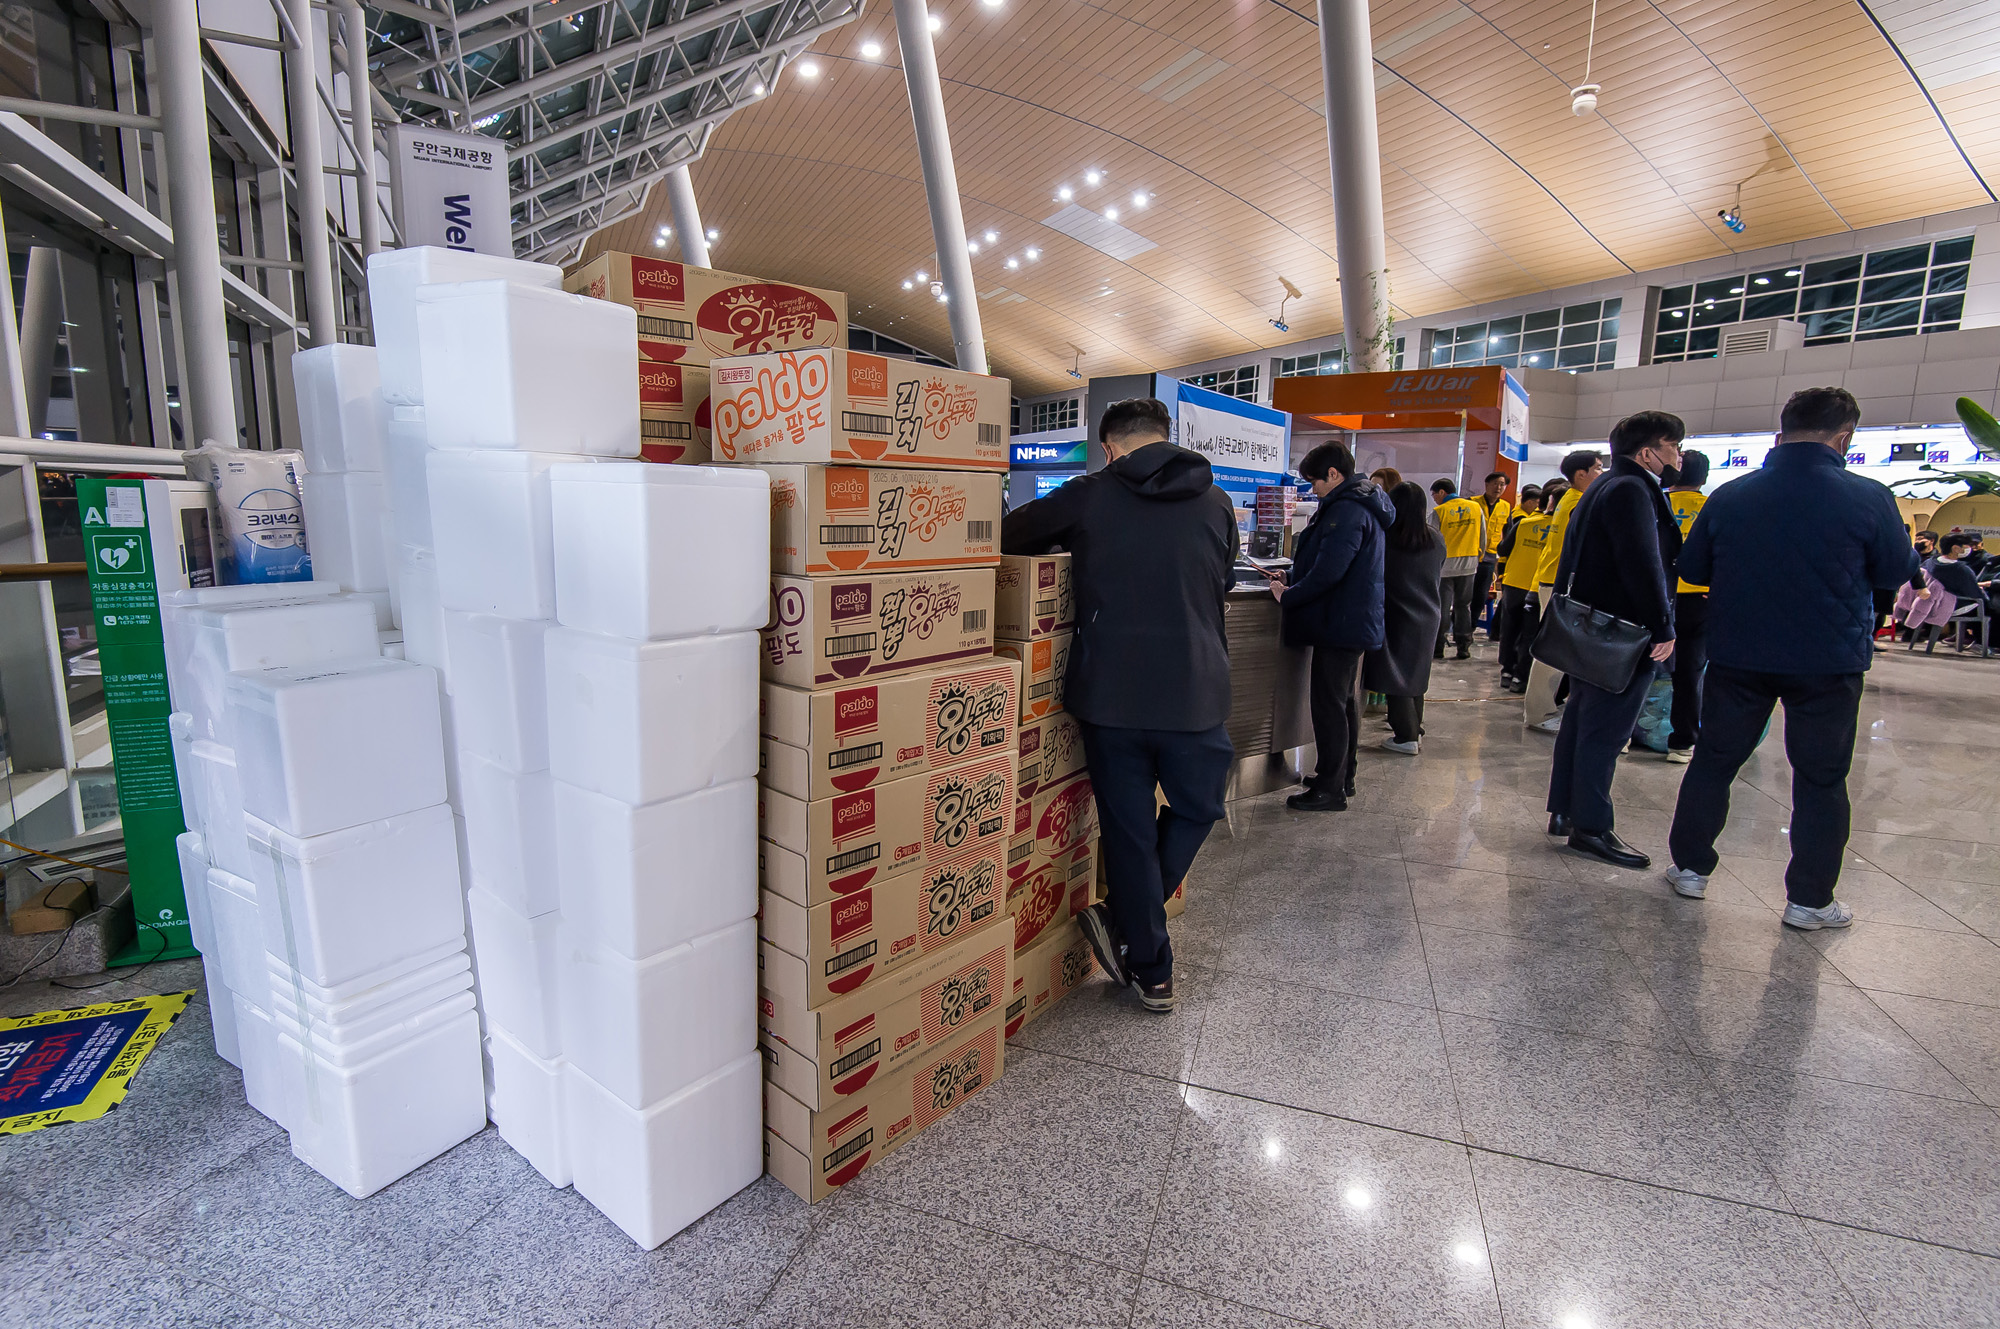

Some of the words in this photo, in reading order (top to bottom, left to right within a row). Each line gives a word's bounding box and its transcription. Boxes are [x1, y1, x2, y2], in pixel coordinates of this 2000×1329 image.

[413, 141, 493, 164] 무안국제공항
[431, 158, 471, 168] INTERNATIONAL
[638, 269, 678, 285] paldo
[728, 307, 818, 354] 왕뚜껑
[720, 369, 751, 383] 김치왕뚜껑
[852, 366, 883, 383] paldo
[715, 352, 828, 460] paldo
[1390, 398, 1411, 406] NEW
[742, 440, 763, 455] 색다른
[763, 429, 784, 447] 즐거움
[785, 402, 826, 445] 팔도
[895, 380, 922, 453] 김치
[924, 391, 978, 440] 왕뚜껑
[1017, 447, 1040, 460] NH
[1041, 448, 1058, 458] Bank
[1219, 435, 1249, 457] 한국교회가
[1251, 441, 1278, 462] 함께합니다
[831, 478, 864, 497] paldo
[248, 513, 300, 526] 크리넥스
[877, 486, 907, 558] 김치
[908, 494, 966, 542] 왕뚜껑
[92, 582, 154, 591] 자동심장충격기
[1058, 567, 1070, 621] 짬뽕
[836, 590, 867, 610] paldo
[879, 588, 906, 661] 짬뽕
[908, 591, 961, 640] 왕뚜껑
[766, 632, 802, 666] 팔도
[104, 675, 118, 683] 긴급
[120, 673, 148, 682] 상황에만
[840, 696, 874, 718] paldo
[935, 690, 1008, 755] 왕뚜껑
[982, 731, 1003, 744] 기획팩
[1043, 725, 1058, 782] 짬뽕
[837, 799, 872, 823] paldo
[933, 780, 1005, 848] 왕뚜껑
[979, 818, 1001, 835] 기획팩
[836, 900, 869, 925] paldo
[927, 864, 996, 937] 왕뚜껑
[941, 969, 990, 1026] 왕뚜껑
[106, 1041, 149, 1079] 물건적재
[136, 1021, 164, 1040] 금지
[0, 1032, 82, 1102] 적재금지
[931, 1049, 980, 1109] 왕뚜껑
[12, 1110, 63, 1129] 금지
